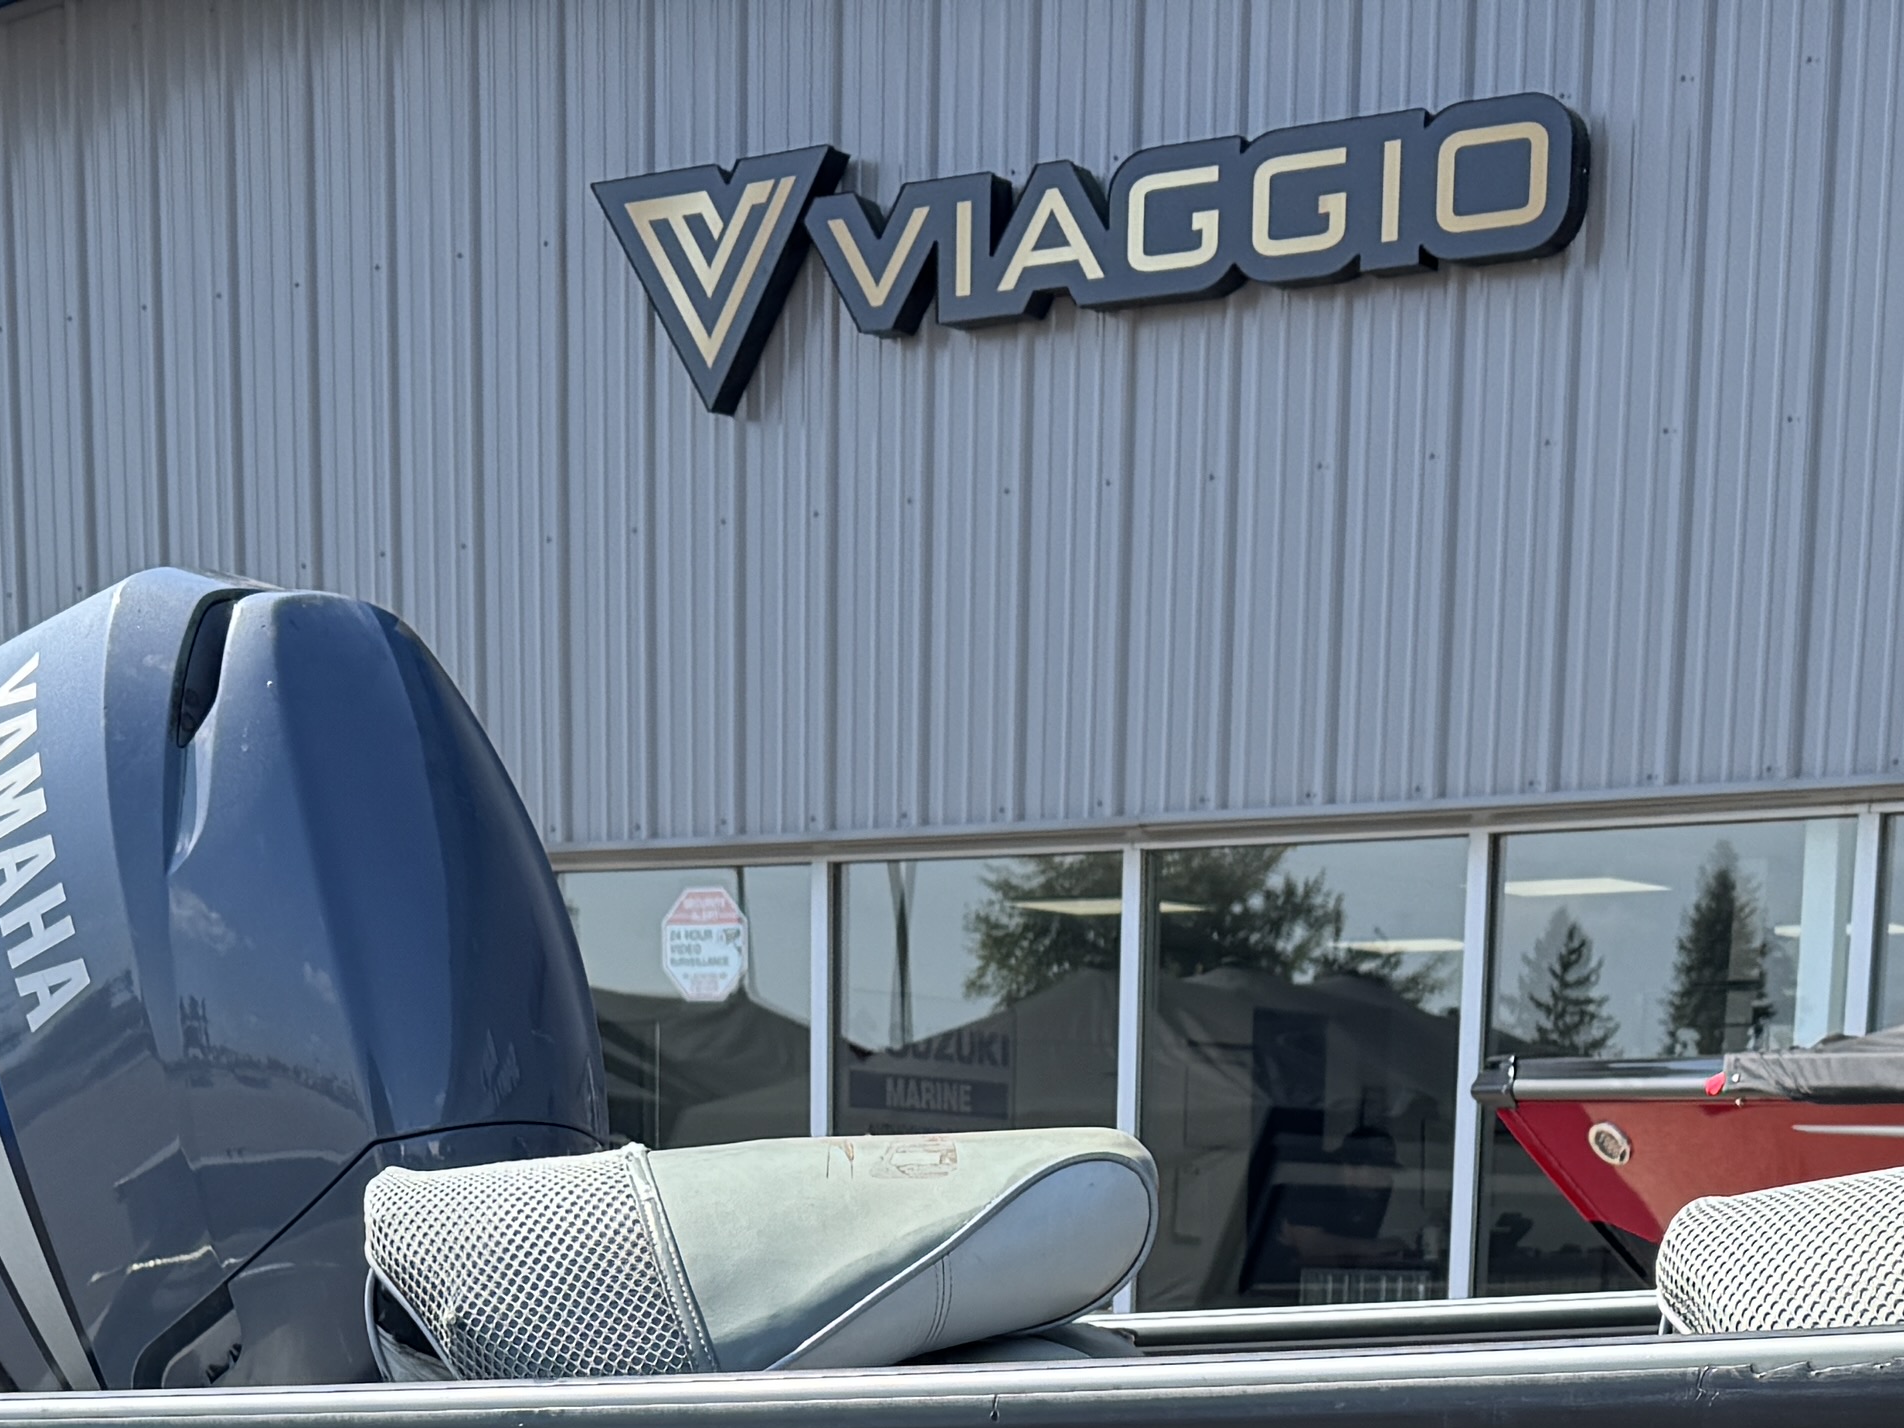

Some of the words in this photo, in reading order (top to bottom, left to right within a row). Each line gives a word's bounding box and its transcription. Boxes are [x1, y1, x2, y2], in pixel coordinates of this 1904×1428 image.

[828, 119, 1548, 309] VIAGGIO
[685, 929, 713, 941] HOUR
[670, 943, 702, 955] VIDEO
[885, 1077, 973, 1113] MARINE
